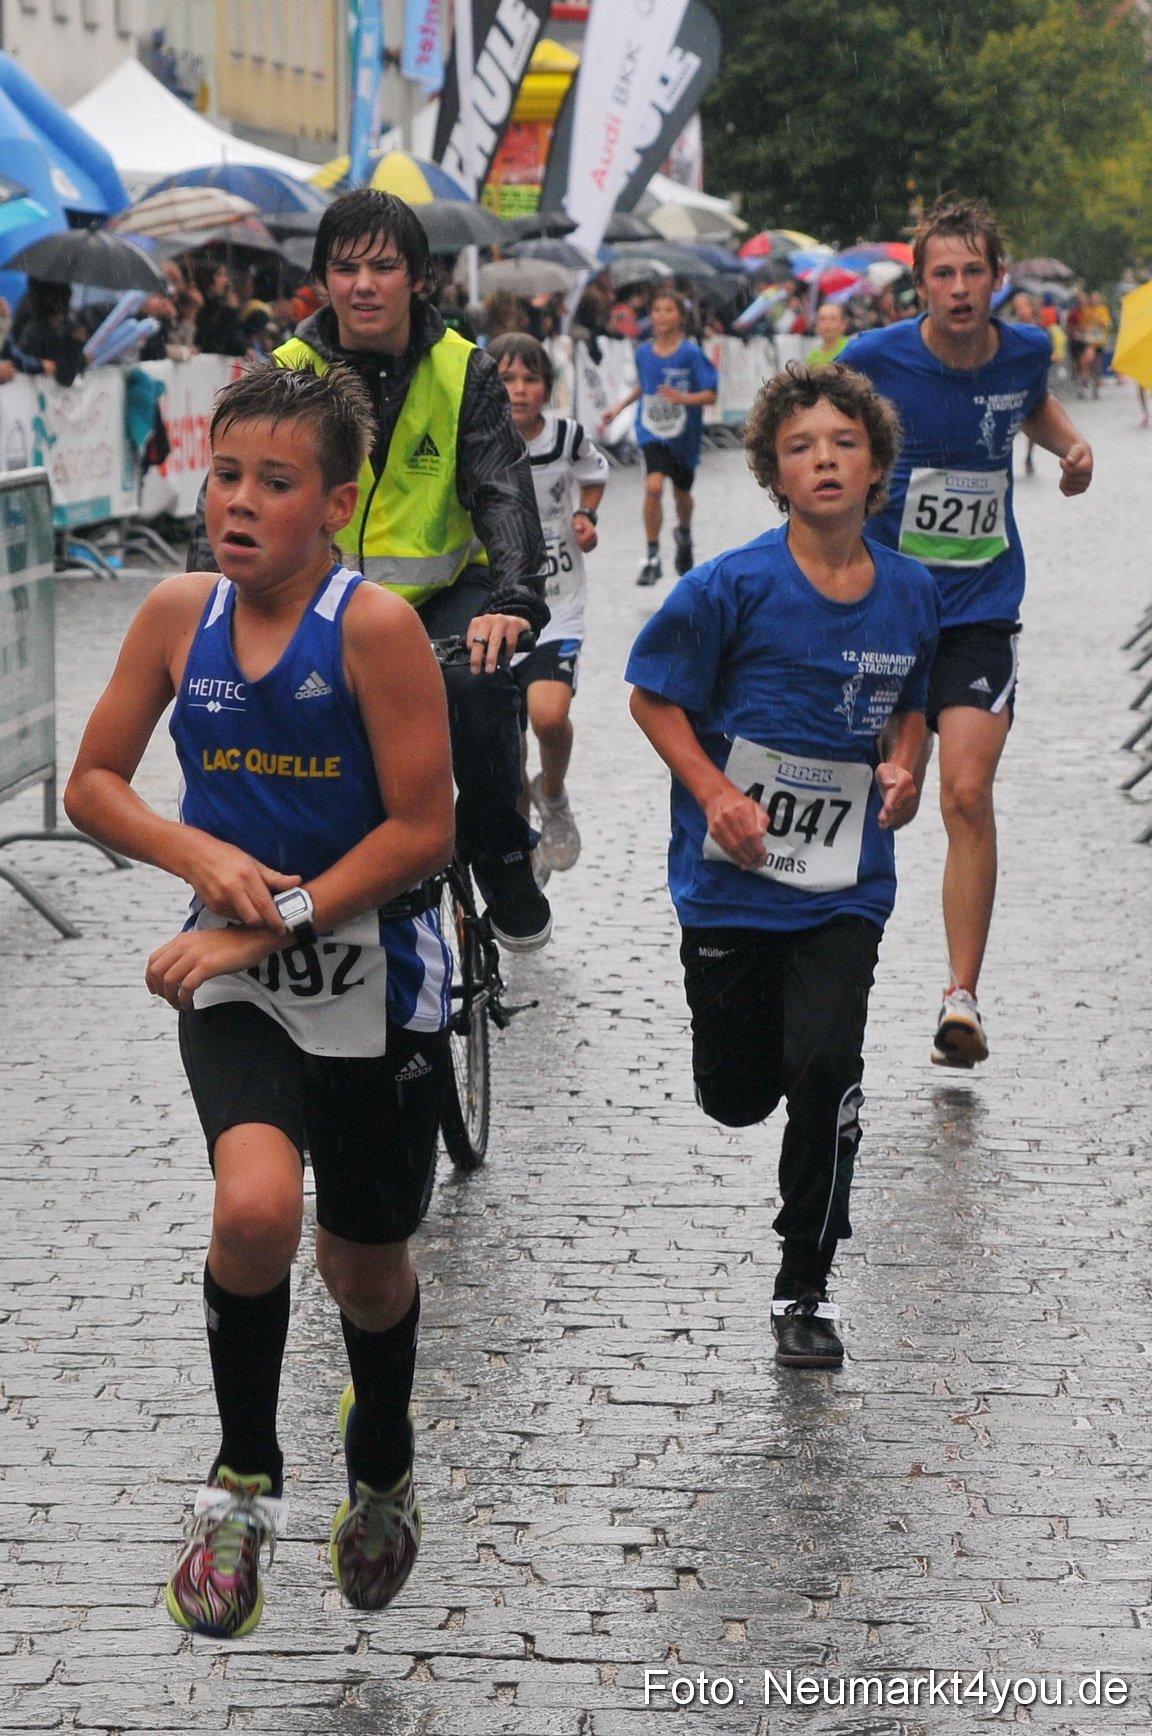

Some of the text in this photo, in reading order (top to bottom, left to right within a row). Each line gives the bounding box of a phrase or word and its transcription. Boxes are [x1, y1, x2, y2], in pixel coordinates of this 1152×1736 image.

[590, 38, 641, 192] Audi BKK
[915, 494, 998, 535] 5218
[546, 541, 573, 577] 55
[841, 650, 859, 662] 12.
[188, 678, 246, 701] HEITEC
[203, 749, 341, 777] LAC QUELLE
[765, 852, 807, 874] onas
[248, 943, 364, 997] 092
[395, 1066, 432, 1081] adidas
